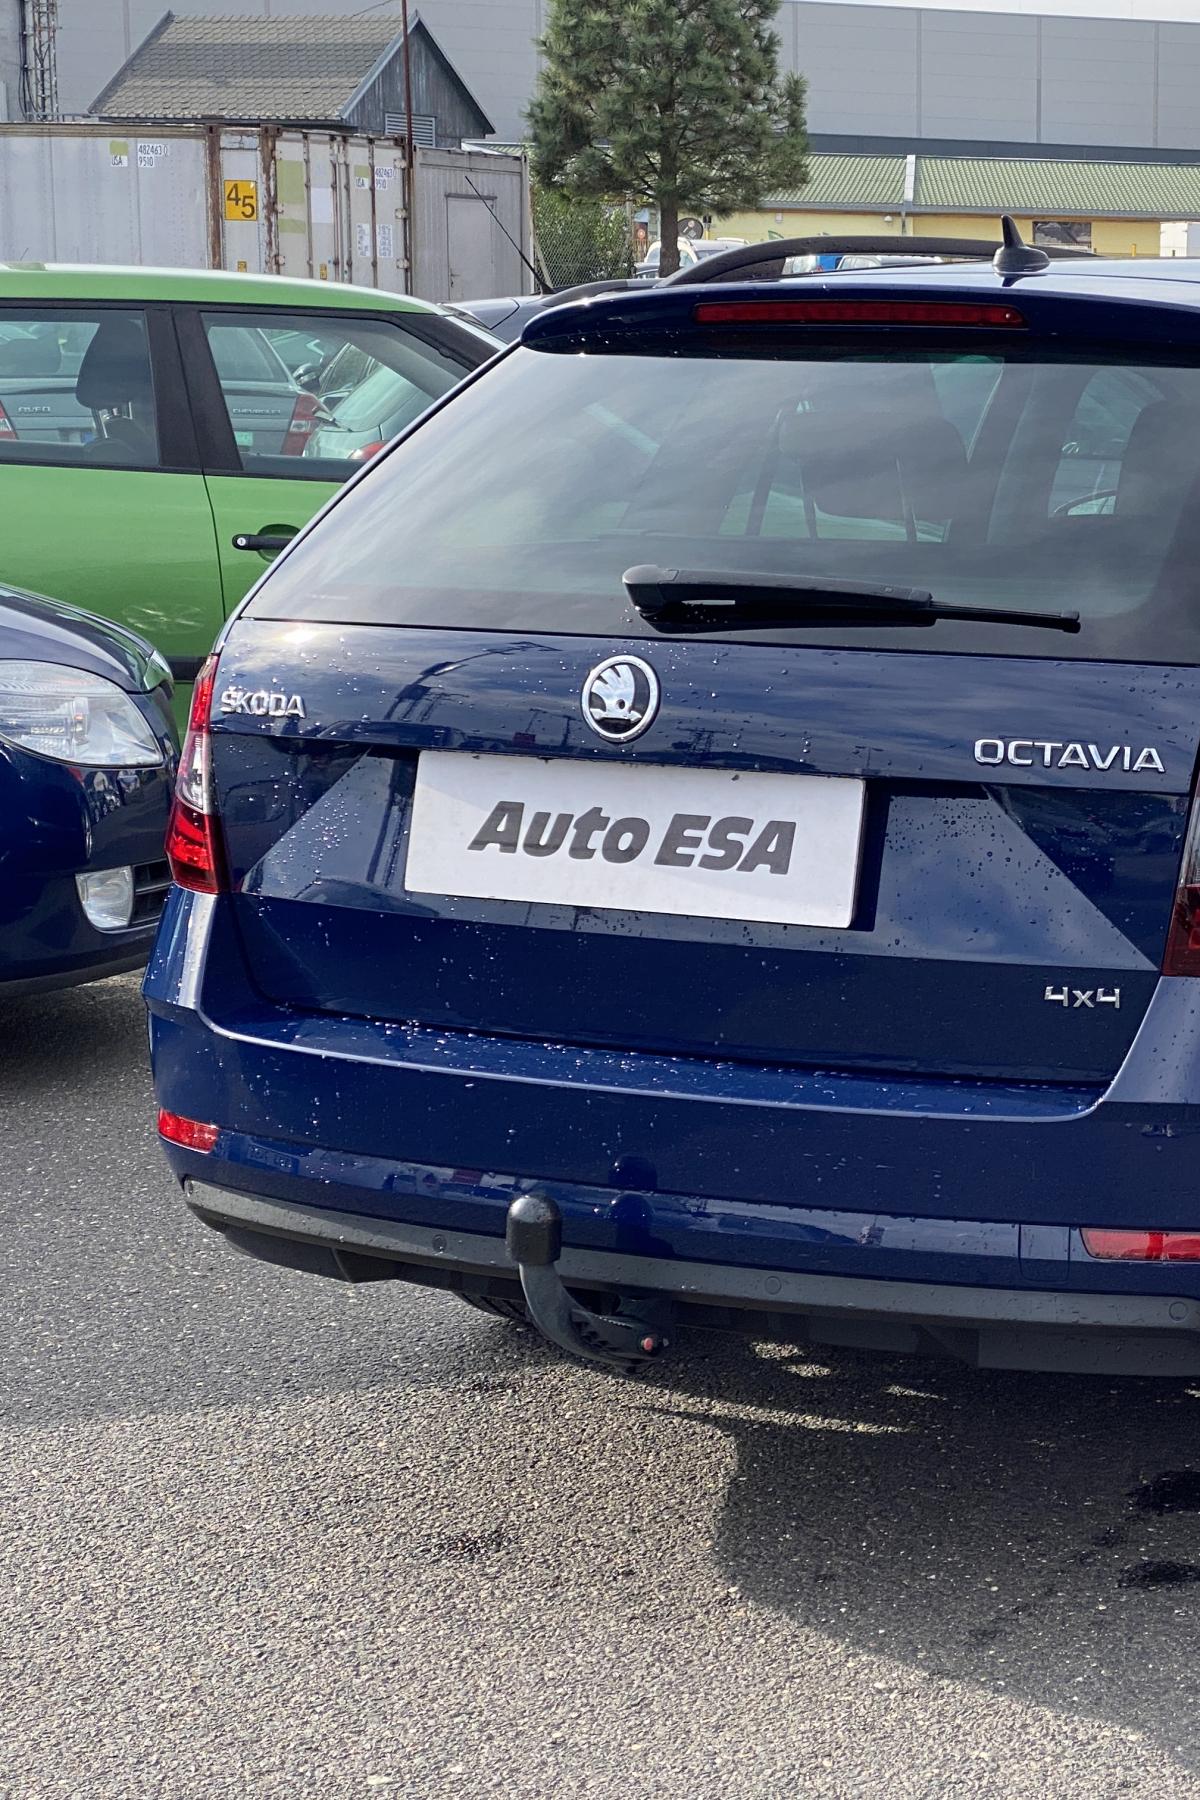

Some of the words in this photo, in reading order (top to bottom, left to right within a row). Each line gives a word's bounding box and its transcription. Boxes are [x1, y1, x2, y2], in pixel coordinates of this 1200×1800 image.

[226, 183, 255, 218] 45
[220, 686, 305, 718] ŠKODA
[973, 738, 1166, 773] OCTAVIA
[466, 800, 651, 864] Auto
[653, 813, 797, 875] ESA
[1044, 986, 1120, 1009] 4x4
